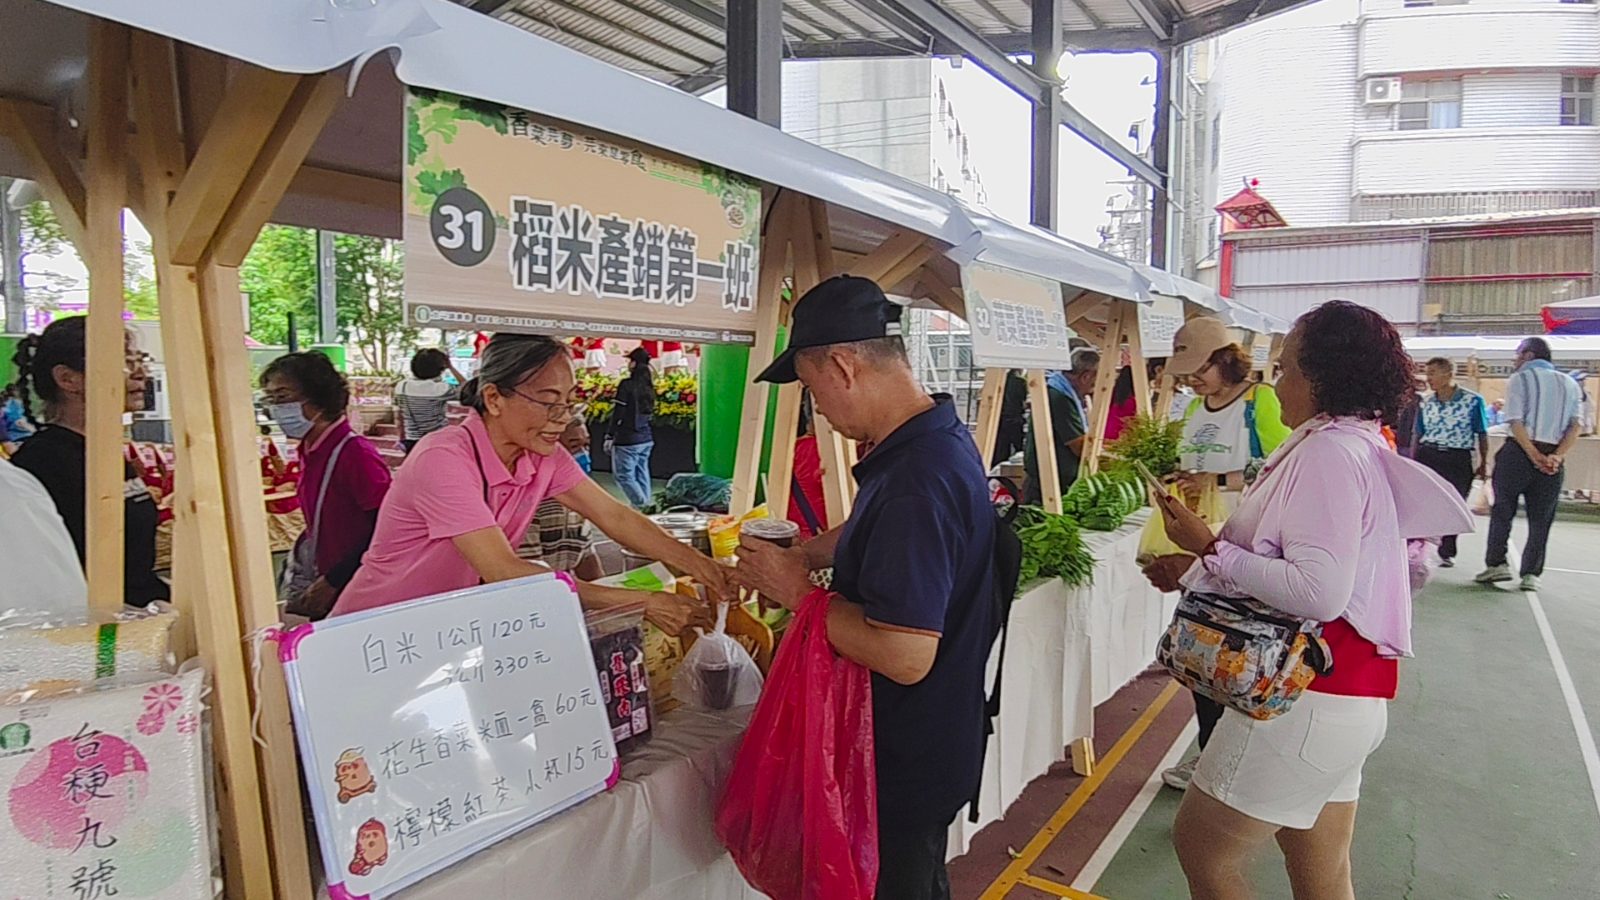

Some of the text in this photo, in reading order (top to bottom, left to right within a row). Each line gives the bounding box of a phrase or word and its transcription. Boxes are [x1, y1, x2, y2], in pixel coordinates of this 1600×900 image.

[438, 205, 484, 251] 31
[509, 197, 754, 312] 稻米產銷第一班
[361, 631, 423, 675] 白米
[492, 612, 546, 639] 120元
[494, 650, 551, 677] 330元
